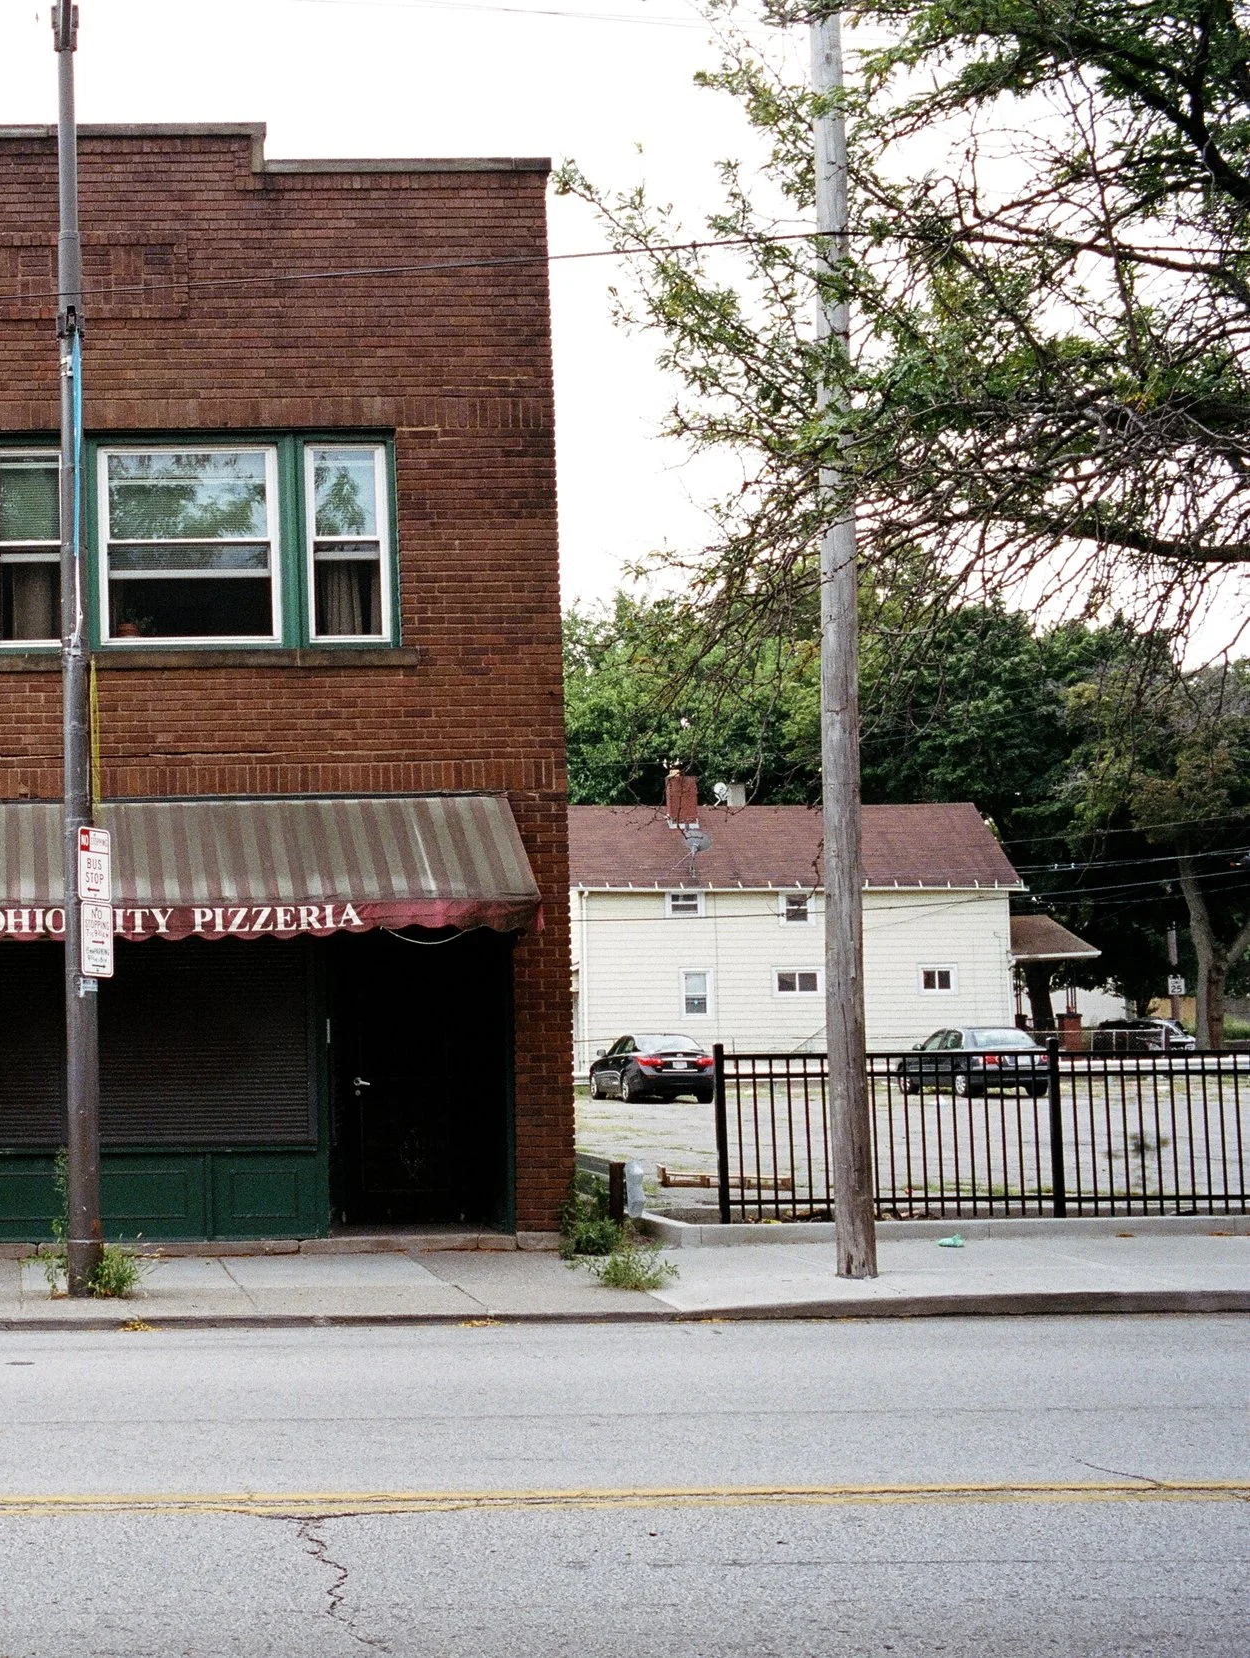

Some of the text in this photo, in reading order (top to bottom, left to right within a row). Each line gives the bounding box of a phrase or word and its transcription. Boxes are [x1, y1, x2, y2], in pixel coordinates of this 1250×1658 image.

[81, 834, 89, 846] NO
[87, 857, 102, 870] BUS
[85, 871, 104, 884] STOP
[91, 909, 103, 919] NO
[113, 908, 175, 933] ITY
[192, 902, 364, 933] PIZZERIA
[85, 919, 109, 931] STOPPING
[1171, 985, 1182, 993] 25
